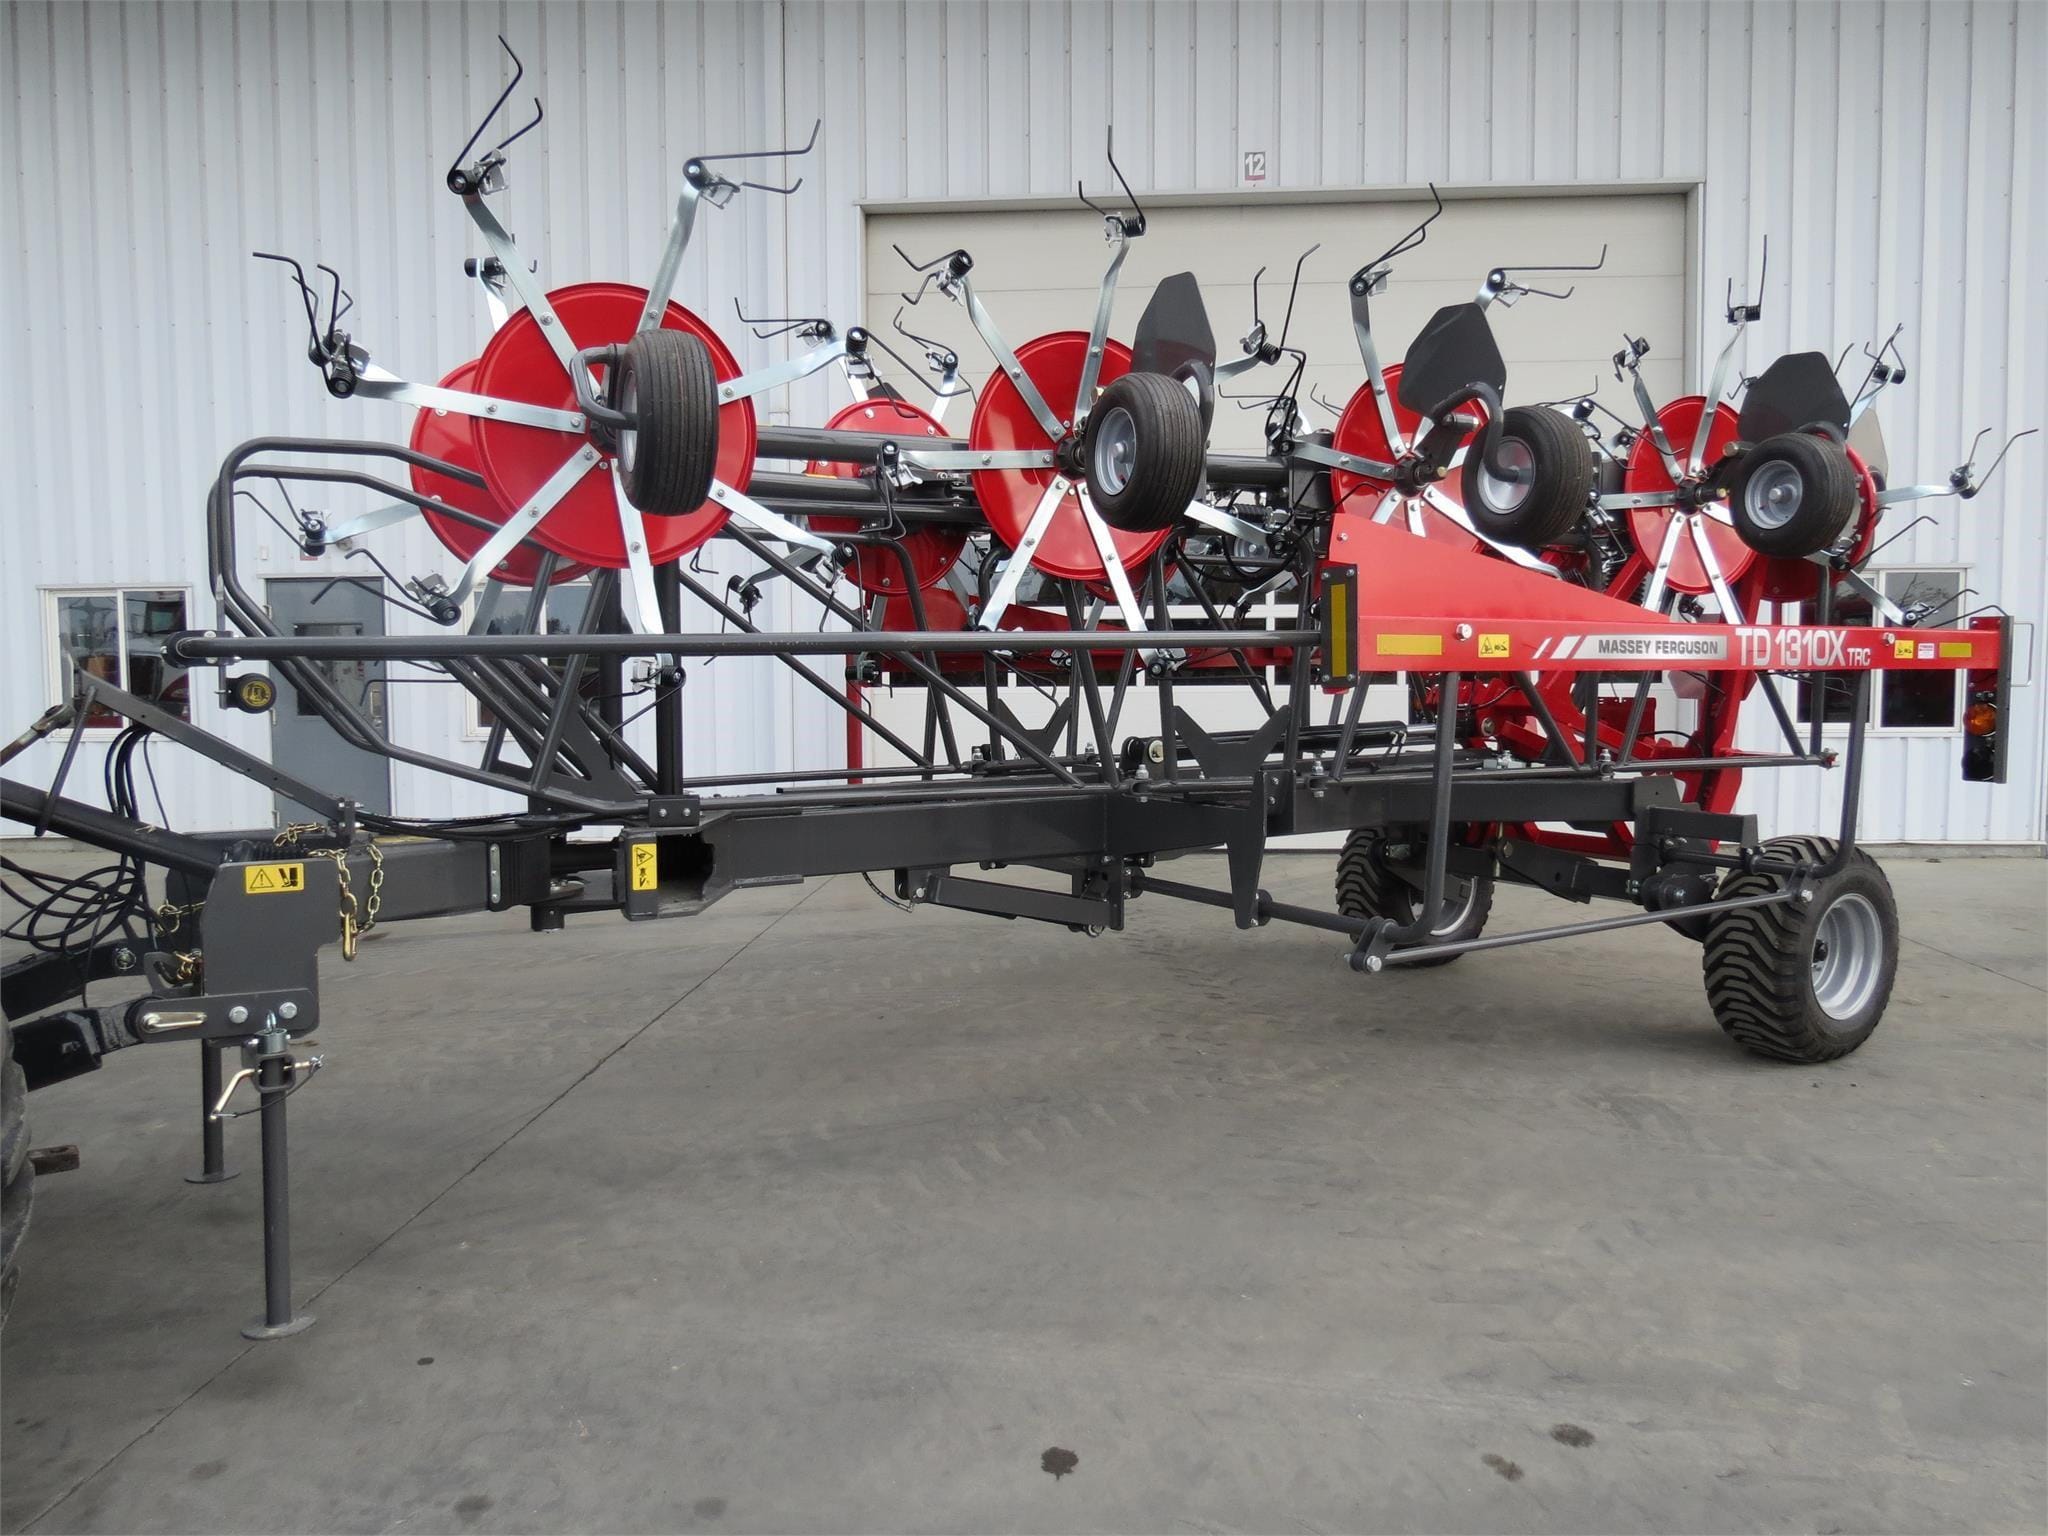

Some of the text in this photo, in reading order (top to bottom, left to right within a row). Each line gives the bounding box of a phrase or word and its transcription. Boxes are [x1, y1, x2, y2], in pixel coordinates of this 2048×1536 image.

[1245, 153, 1265, 176] 12
[1598, 639, 1718, 654] MASSEY FERGUSON
[1735, 627, 1871, 666] TD 1310X TRC
